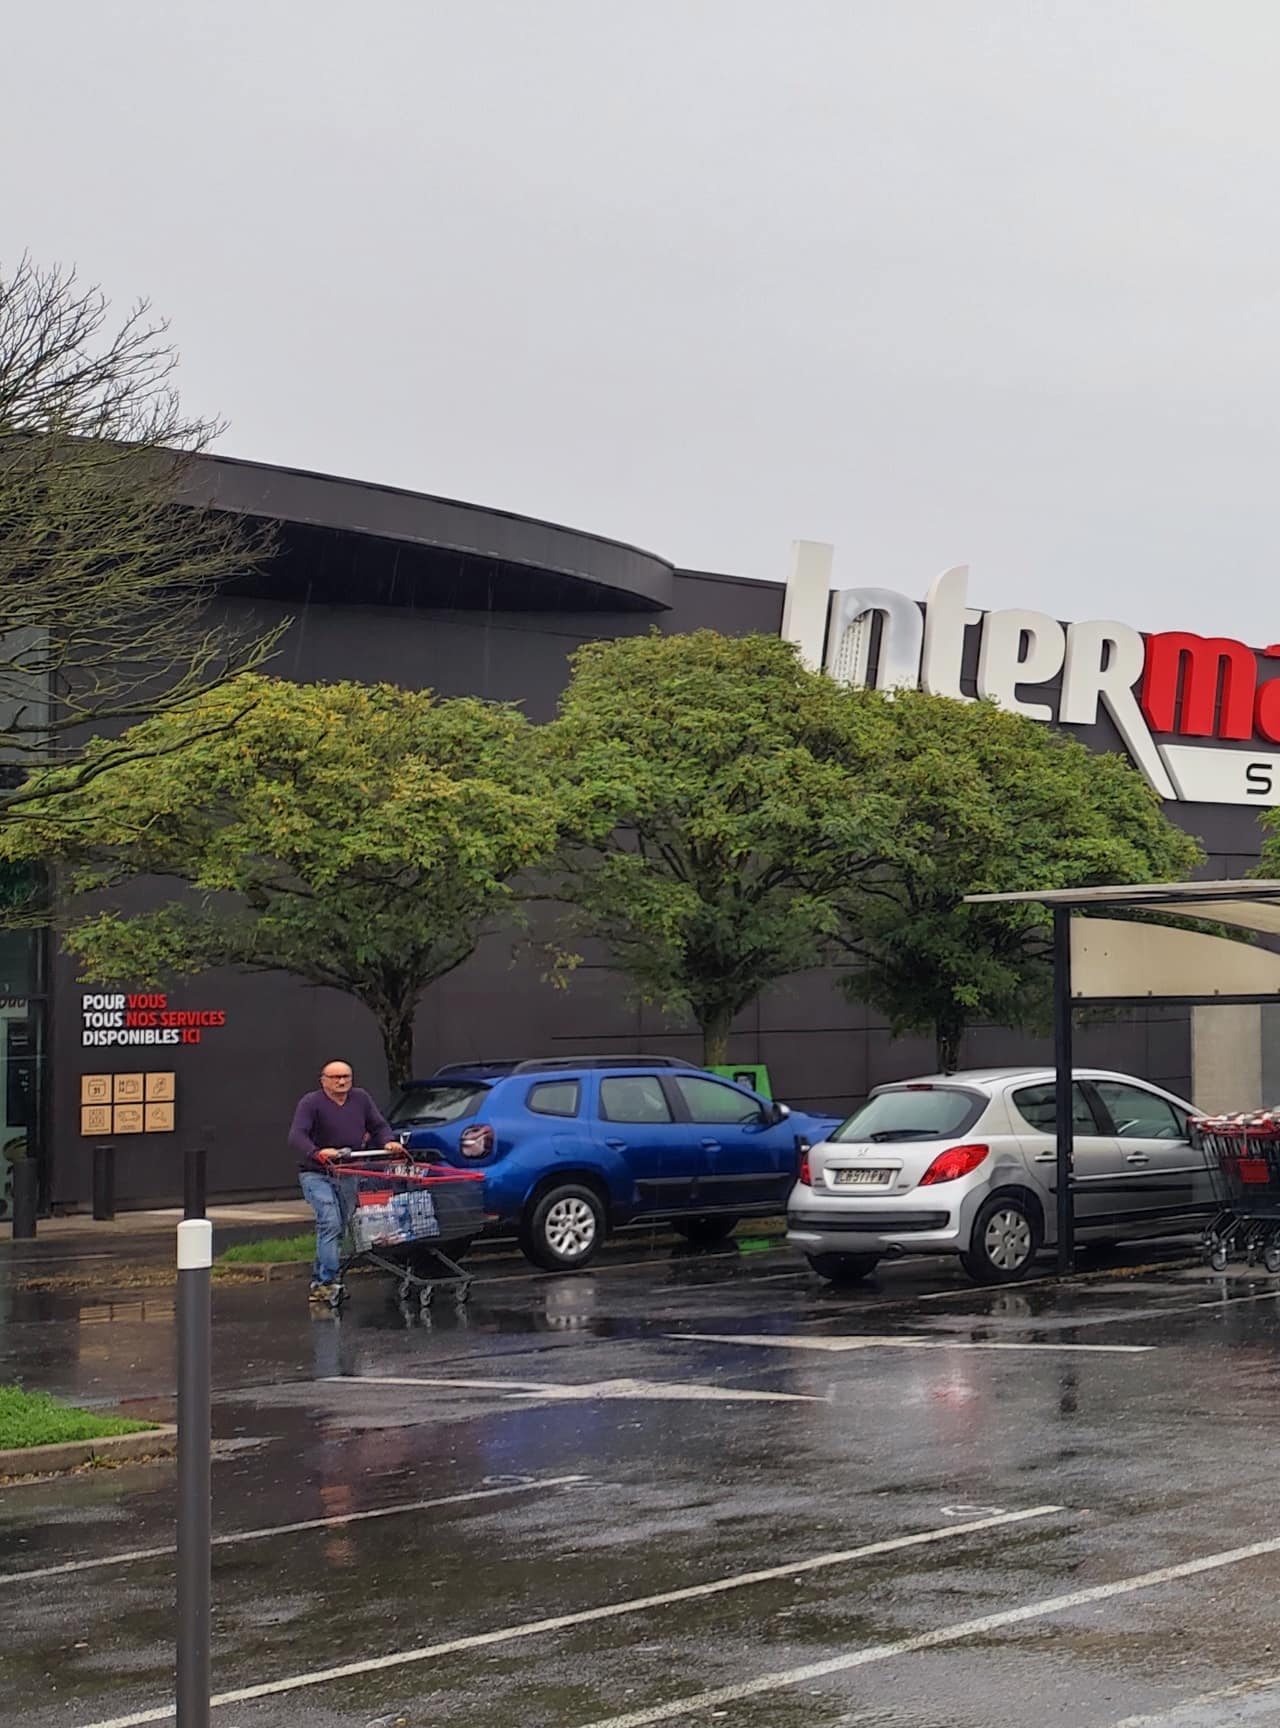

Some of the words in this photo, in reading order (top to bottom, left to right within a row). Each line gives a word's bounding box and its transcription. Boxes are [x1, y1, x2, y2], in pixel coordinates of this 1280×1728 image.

[82, 994, 125, 1010] POUR
[127, 994, 167, 1008] VOUS
[83, 1012, 123, 1027] TOUS
[126, 1012, 157, 1026] NOS
[159, 1010, 225, 1026] SERVICES
[82, 1029, 179, 1046] DISPONIBLES
[182, 1029, 201, 1043] ICI
